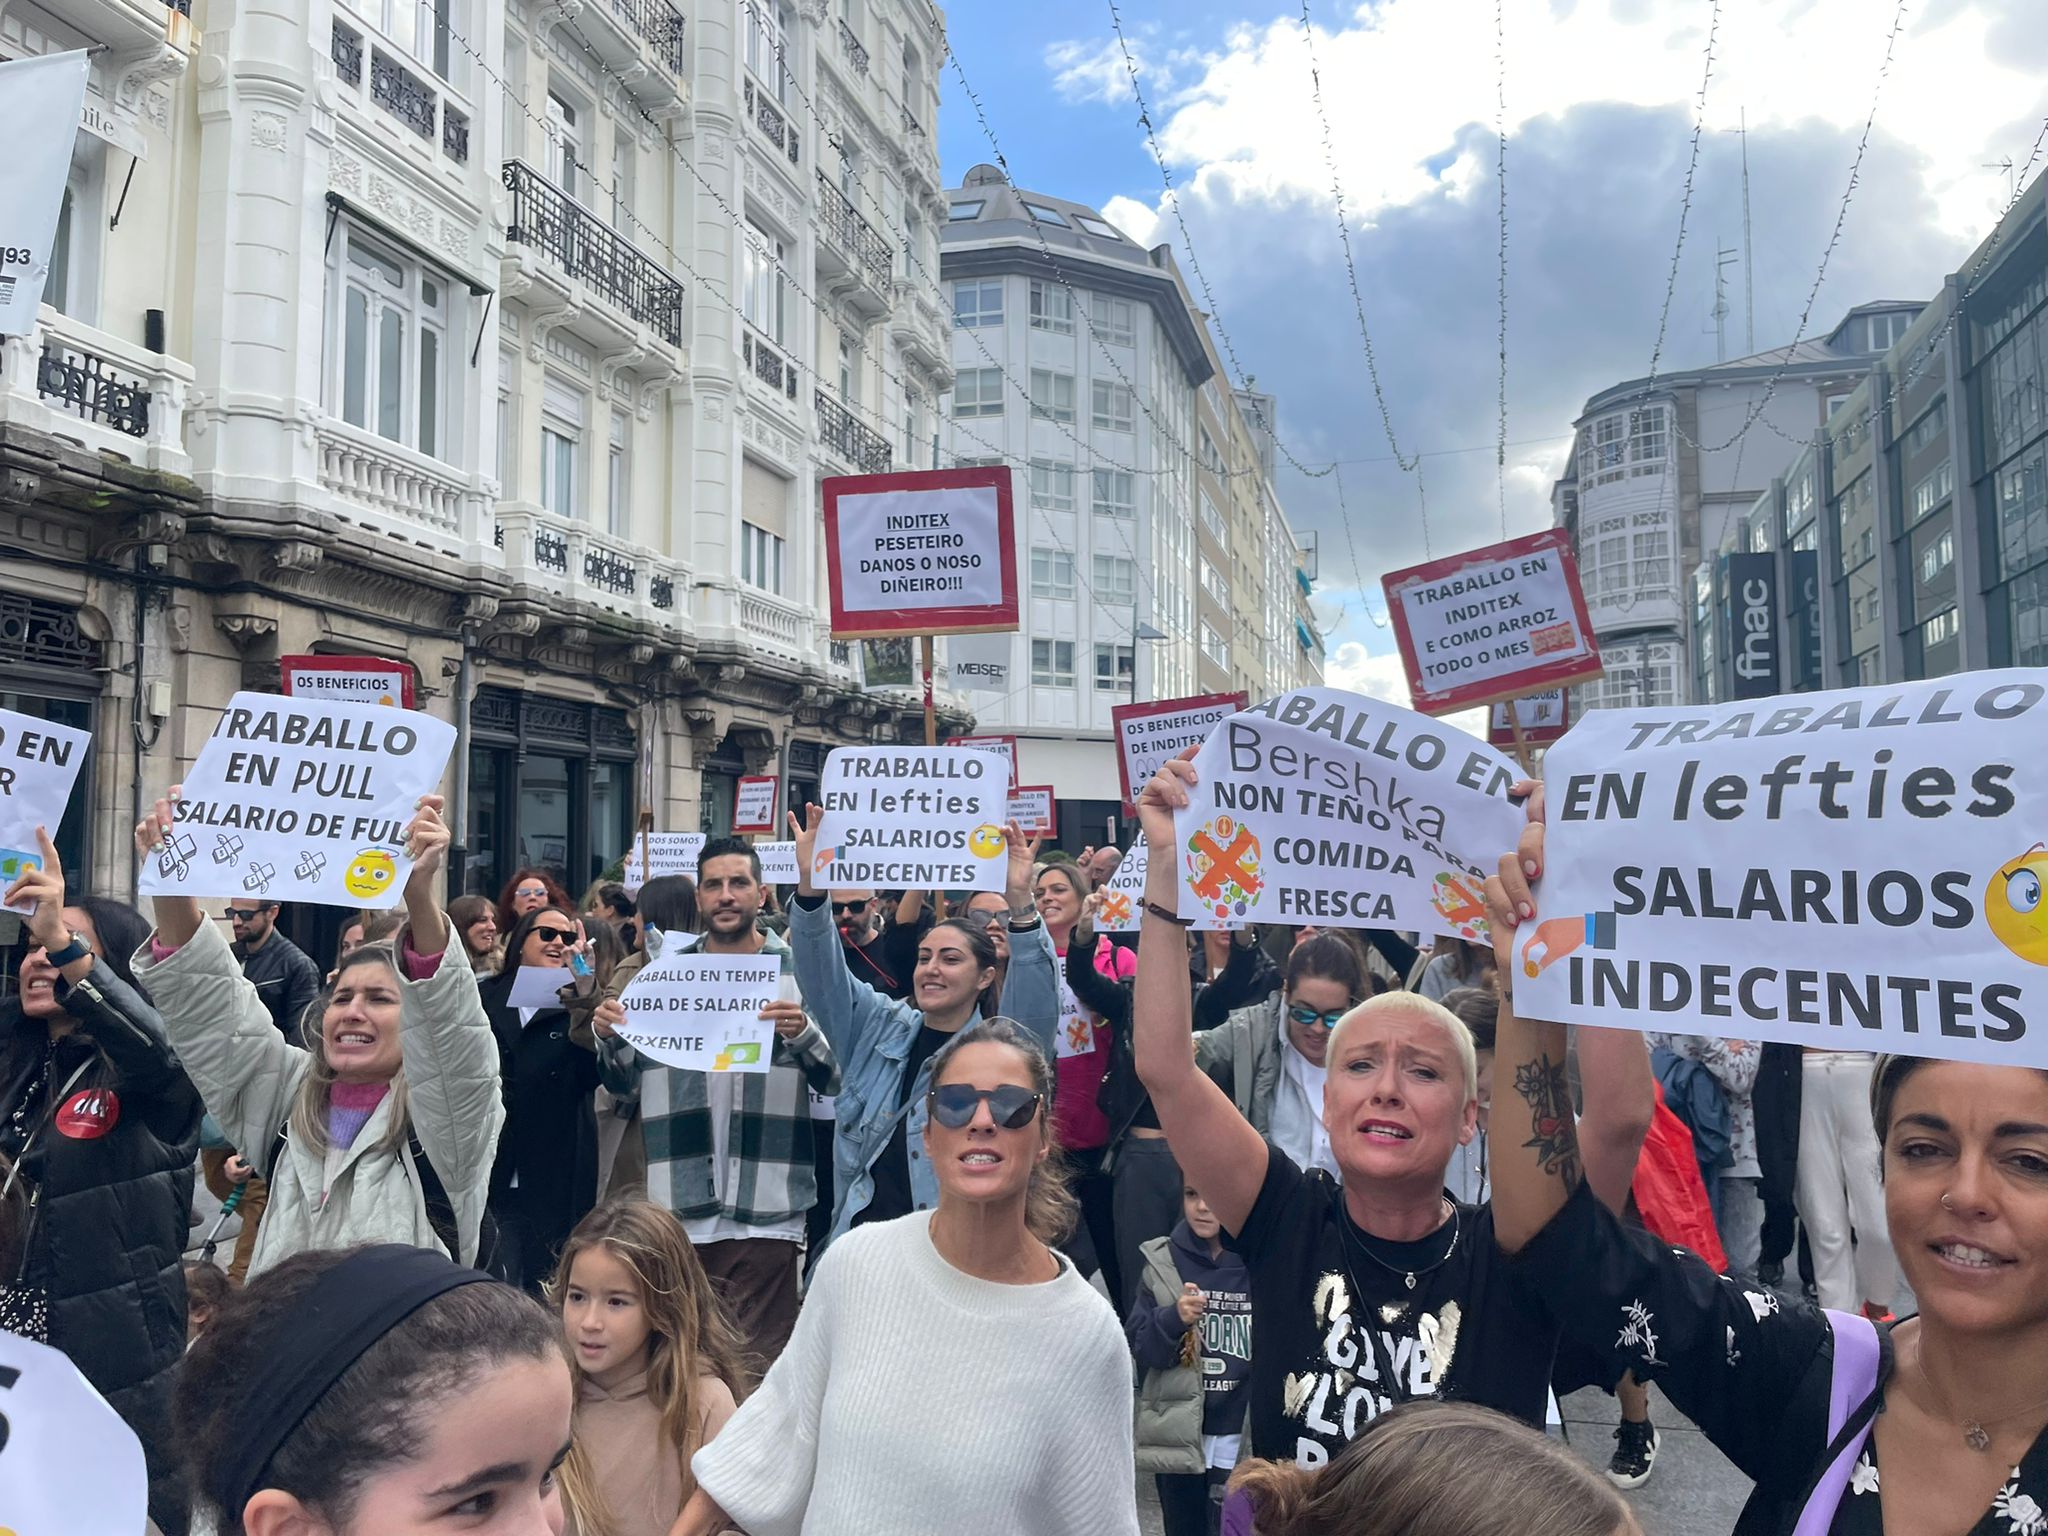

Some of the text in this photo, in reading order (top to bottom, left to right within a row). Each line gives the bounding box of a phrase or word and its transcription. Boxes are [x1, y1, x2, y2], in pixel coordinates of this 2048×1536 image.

[886, 513, 950, 530] INDITEX
[875, 533, 964, 551] PESETEIRO
[860, 554, 982, 573] DANOS O NOSO
[880, 575, 963, 594] DIÑEIRO!!!
[1414, 558, 1548, 606] TRABALLO EN
[1445, 592, 1523, 625] INDITEX
[1425, 607, 1558, 653] E COMO ARROZ
[1736, 579, 1771, 680] fnac
[957, 663, 1003, 677] MEISEL
[1425, 640, 1530, 678] TODO O MES
[297, 677, 389, 691] OS BENEFICIOS
[1127, 711, 1223, 735] OS BENEFICIOS
[1624, 683, 2046, 751] TRABALLO
[1246, 694, 1447, 772] ABALLO
[16, 731, 73, 767] EN
[1131, 742, 1148, 754] DE
[225, 752, 375, 800] EN PULL
[840, 757, 984, 780] TRABALLO
[1229, 722, 1446, 843] Bershka
[1560, 749, 2015, 821] EN lefties
[825, 788, 980, 815] EN lefties
[173, 800, 298, 834] SALARIO
[306, 813, 345, 839] DE
[1213, 781, 1487, 881] NON TEÑO PARA
[637, 836, 700, 845] TDOS SOMOS
[844, 828, 966, 849] SALARIOS
[648, 848, 685, 857] INDITEX
[1274, 836, 1417, 879] COMIDA
[760, 863, 795, 872] RXENTE
[829, 862, 976, 883] INDECENTES
[1111, 877, 1143, 889] NON
[1279, 887, 1397, 921] FRESCA
[1613, 865, 1975, 930] SALARIOS
[700, 970, 720, 982] EN
[725, 970, 775, 983] TEMPE
[622, 998, 664, 1011] SUBA
[669, 998, 689, 1011] DE
[1568, 956, 2027, 1042] INDECENTES
